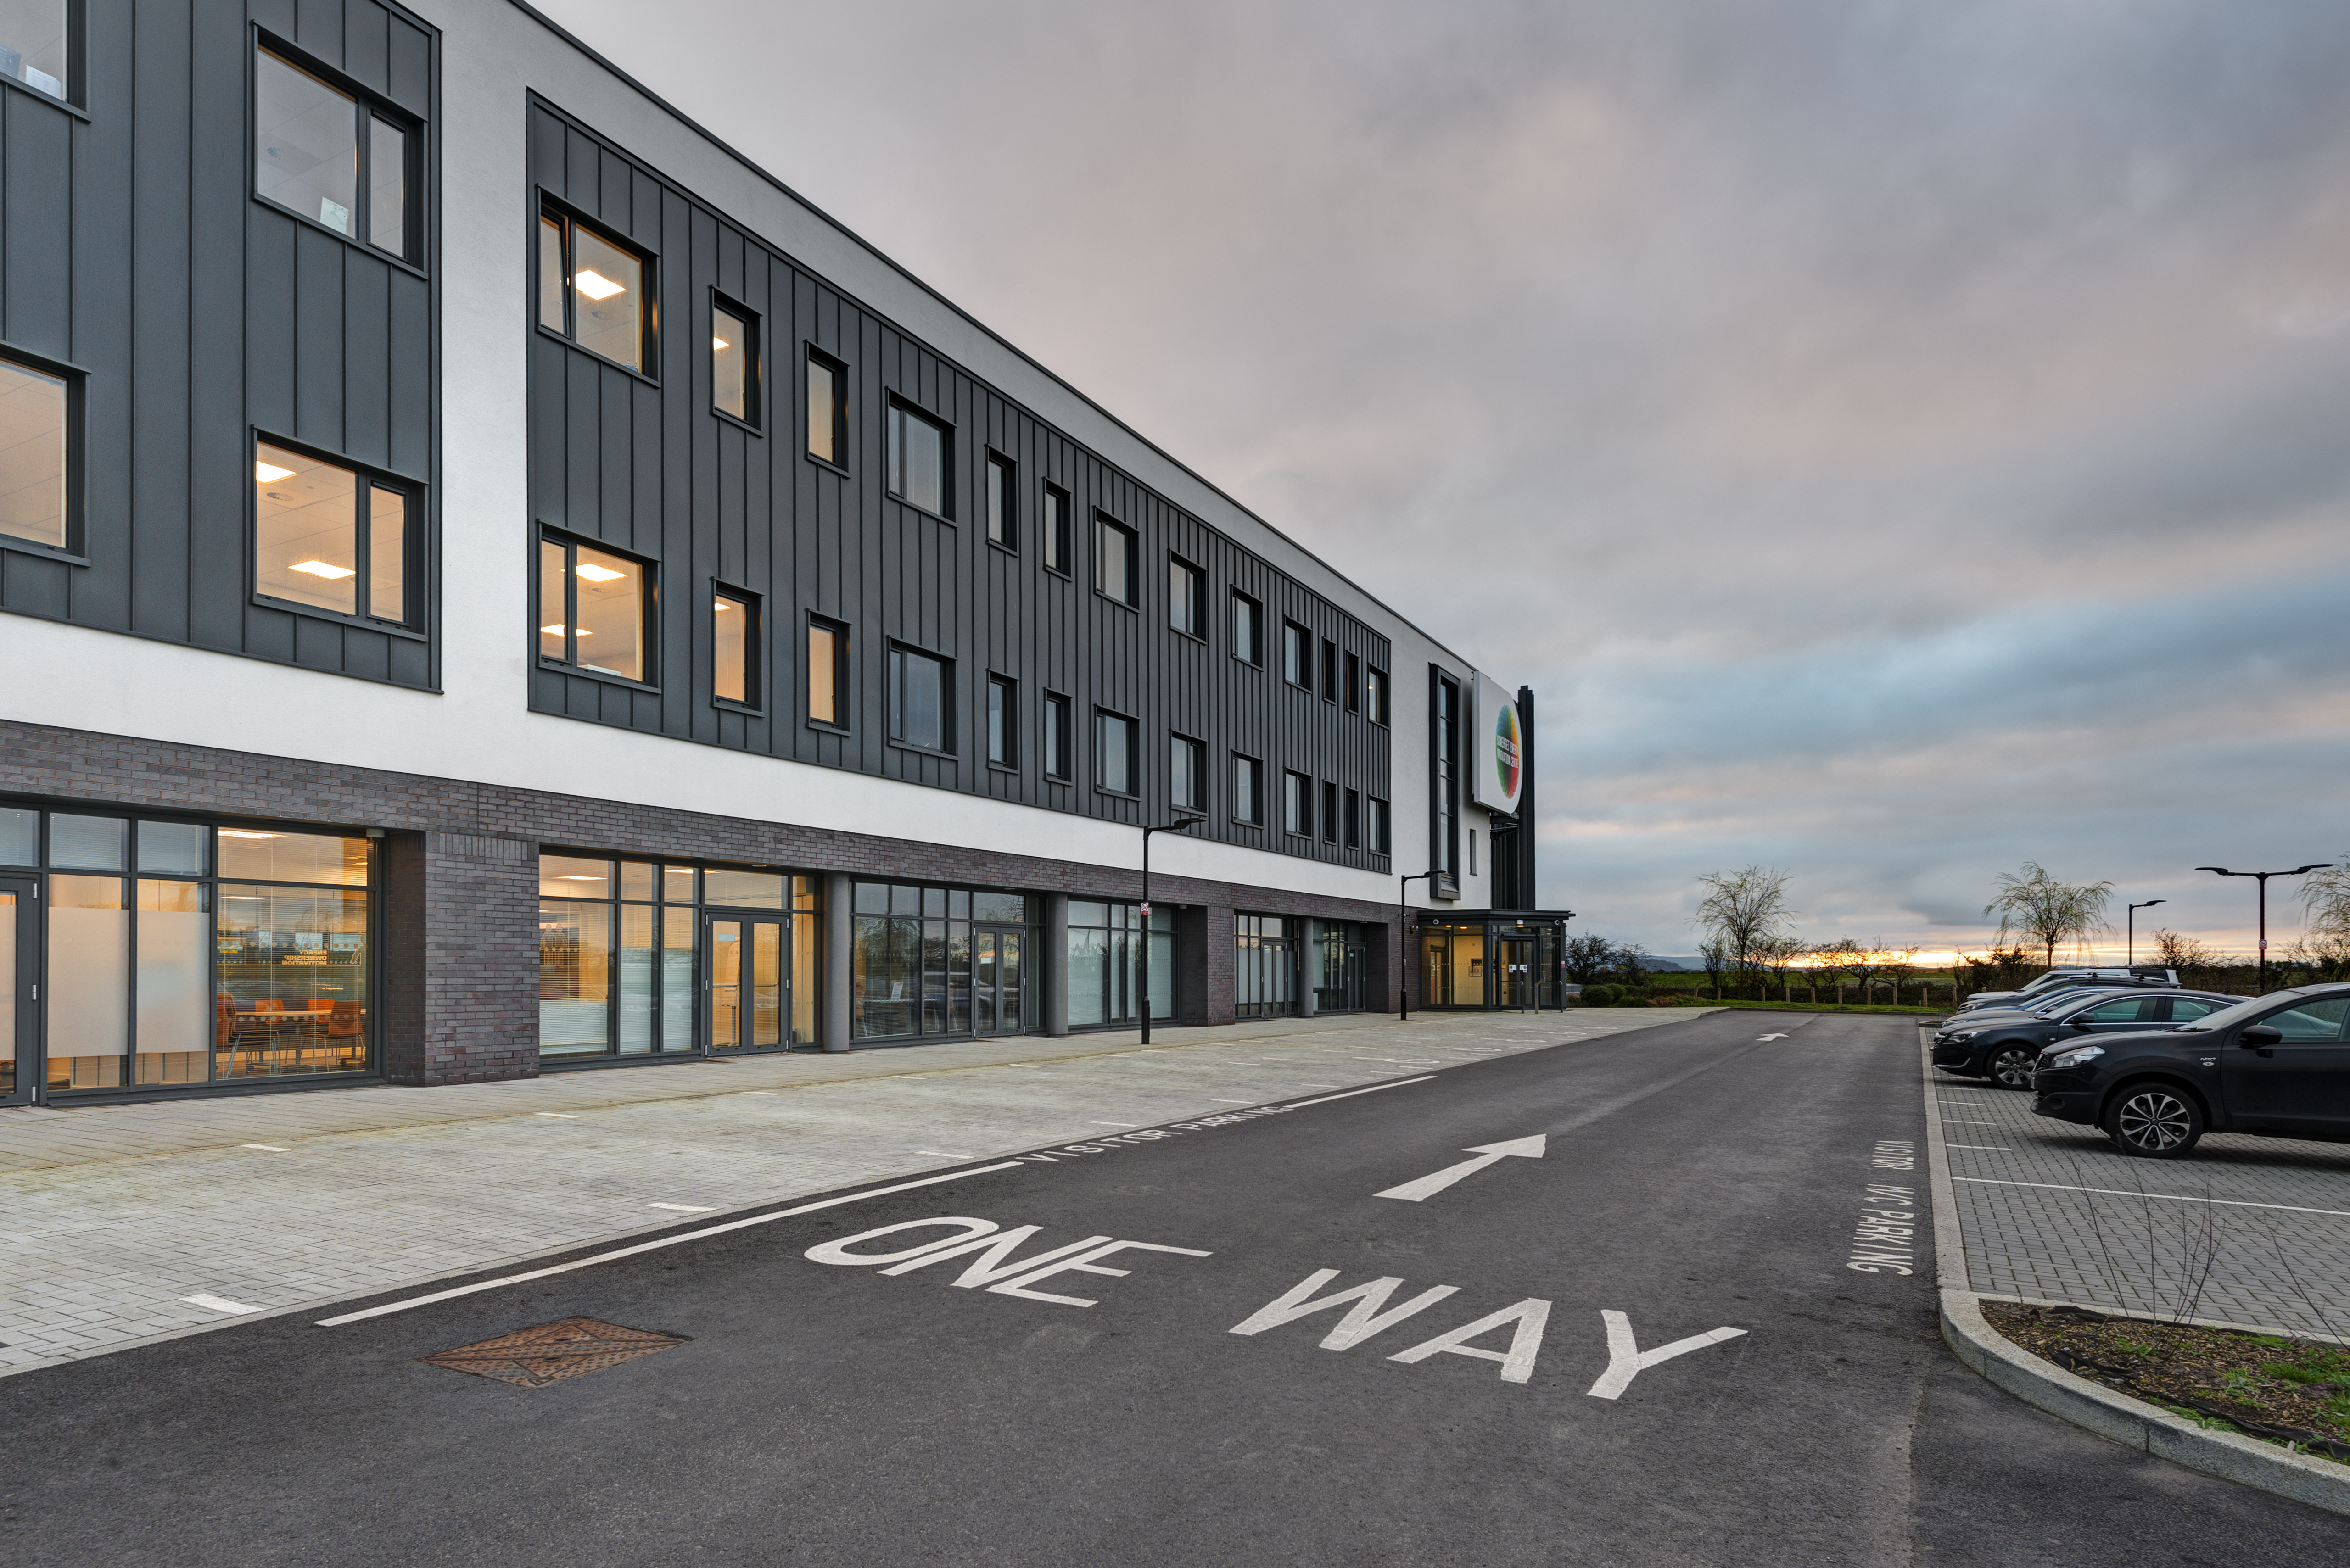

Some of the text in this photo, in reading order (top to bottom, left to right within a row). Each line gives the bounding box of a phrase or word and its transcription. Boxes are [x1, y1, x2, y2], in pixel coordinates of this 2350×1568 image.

[1497, 735, 1510, 752] SOMERSET
[1497, 748, 1519, 768] INNOVATION CENTRE
[1015, 1106, 1294, 1161] VISITOR PARKING
[1846, 1140, 1915, 1276] VISITOR M/C PARKING
[803, 1216, 1749, 1400] ONE WAY
